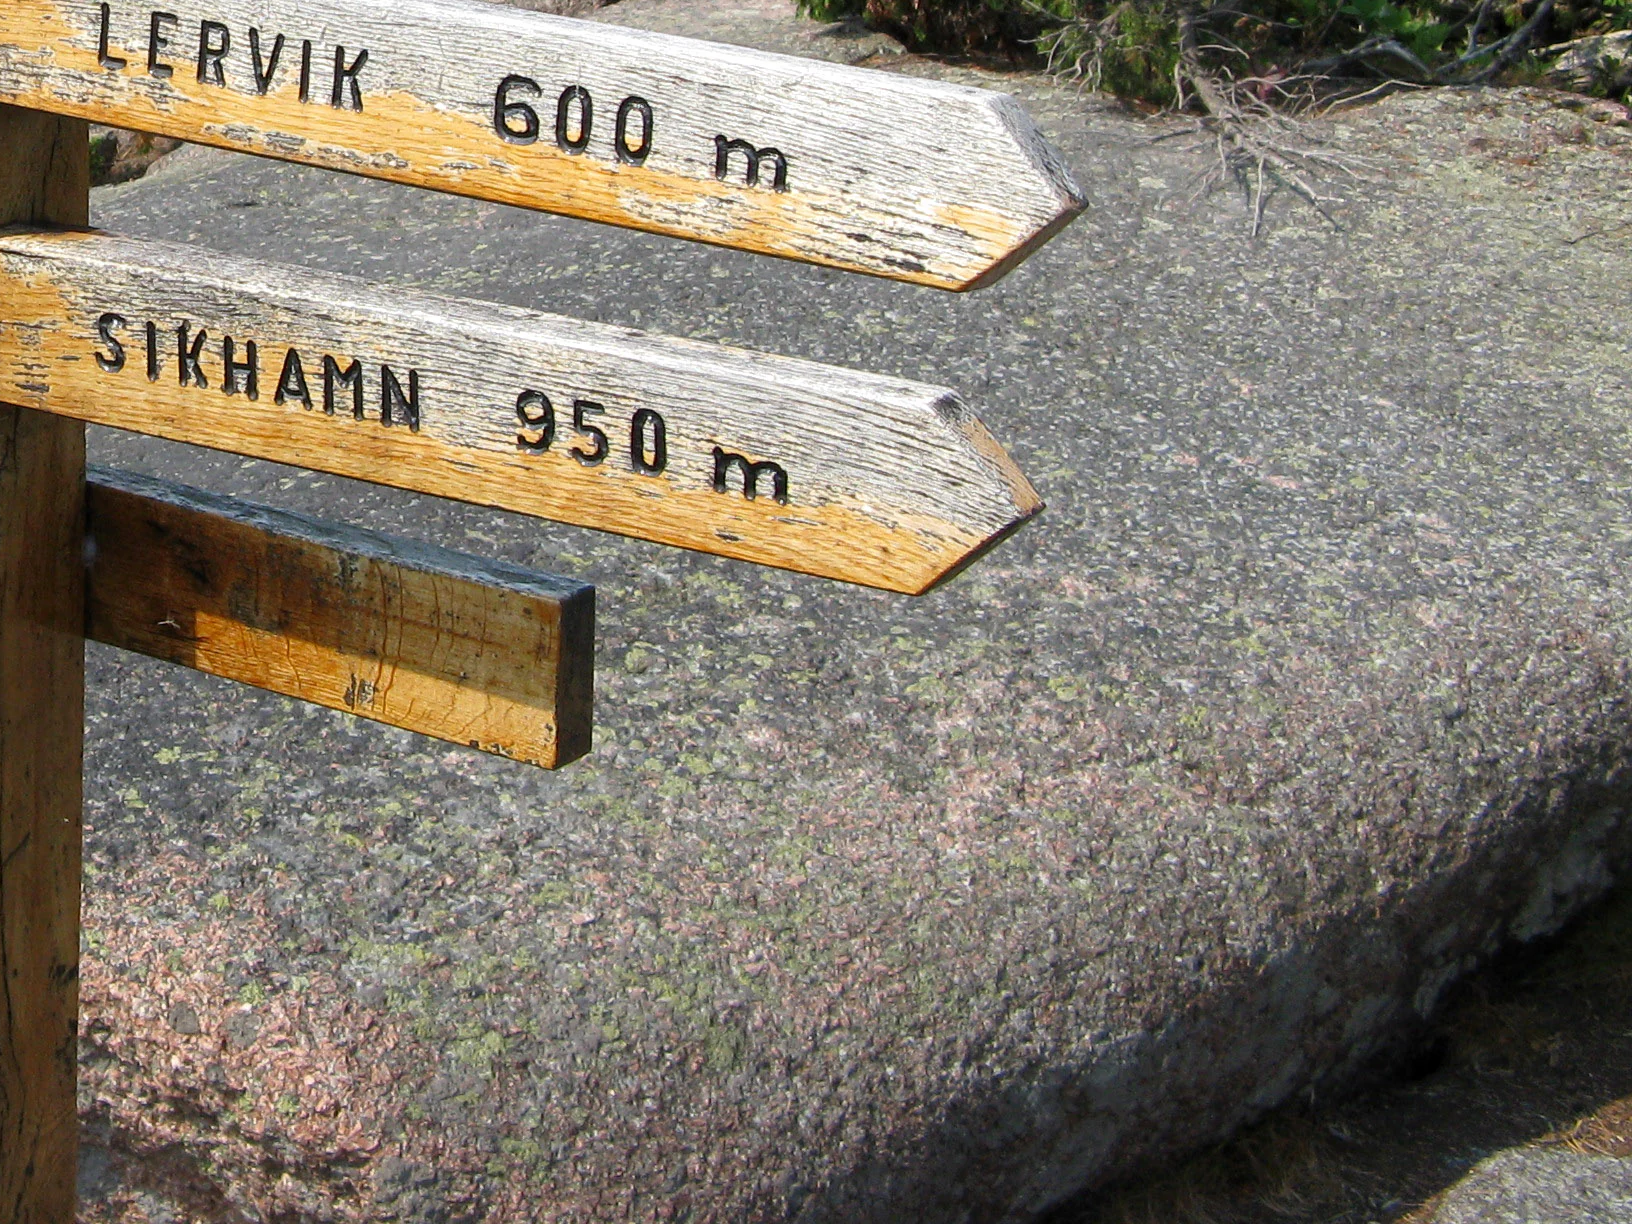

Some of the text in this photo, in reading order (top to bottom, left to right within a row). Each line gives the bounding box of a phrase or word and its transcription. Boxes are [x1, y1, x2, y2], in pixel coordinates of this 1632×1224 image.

[97, 2, 790, 194] LERVIK 600 m
[95, 312, 790, 507] SIKHAMN 950 m
